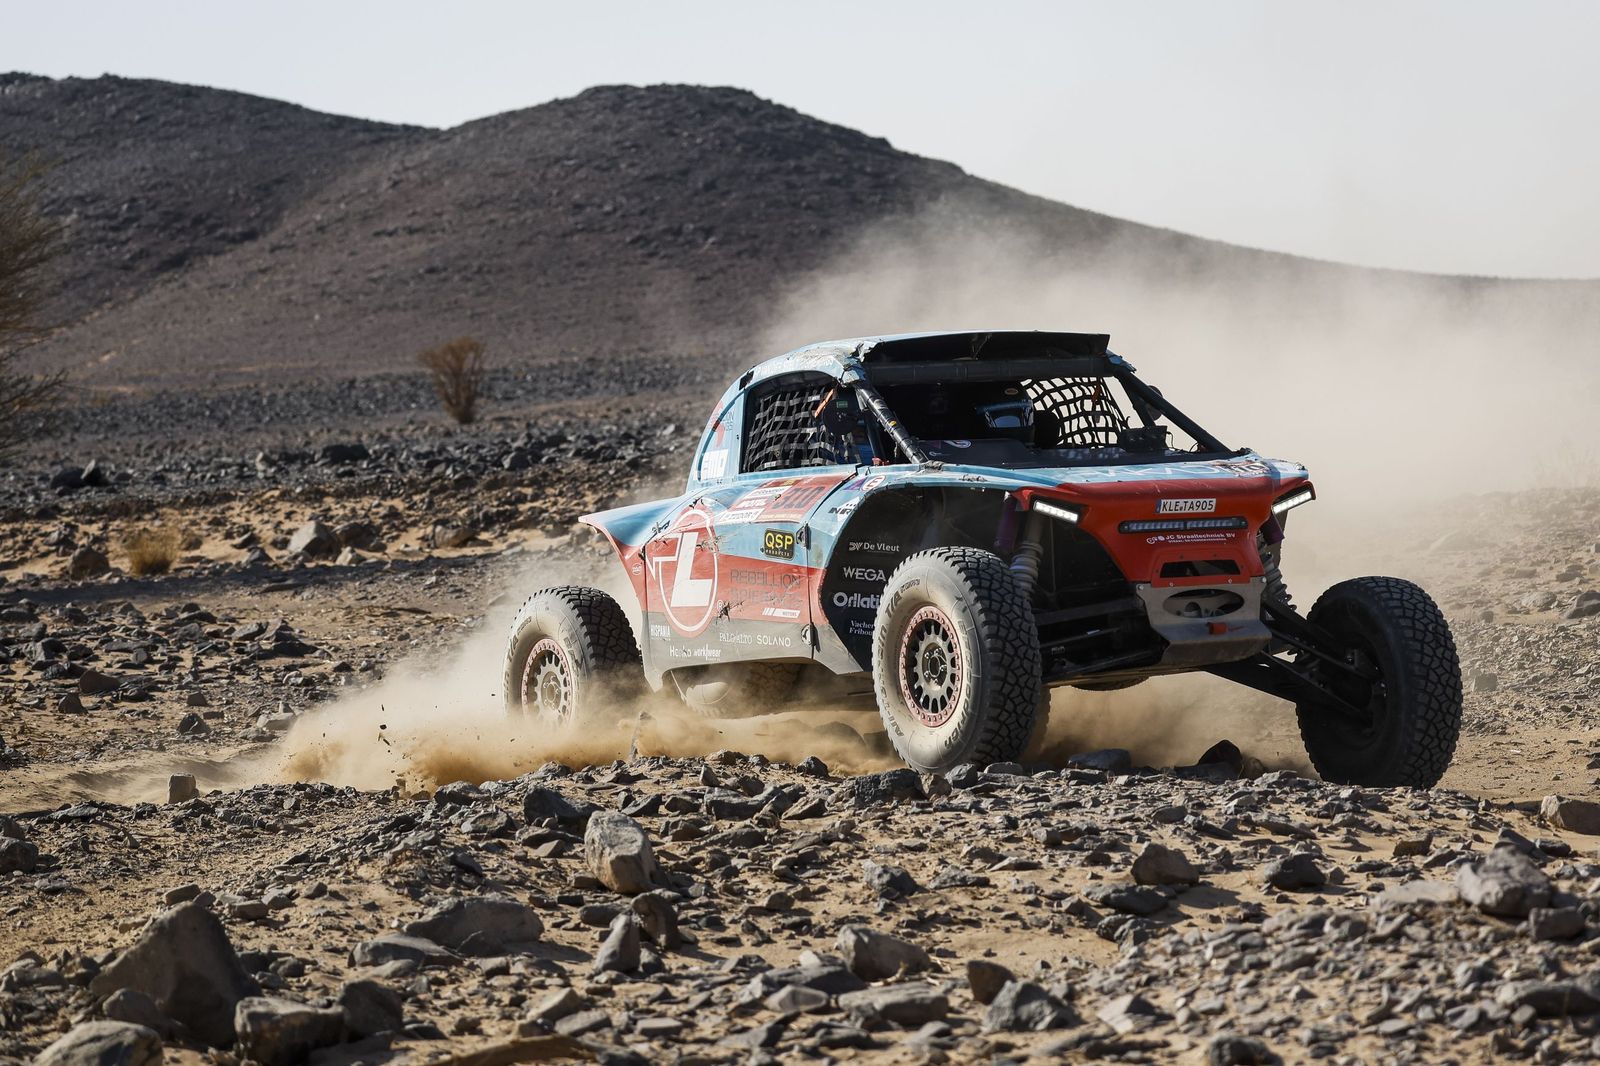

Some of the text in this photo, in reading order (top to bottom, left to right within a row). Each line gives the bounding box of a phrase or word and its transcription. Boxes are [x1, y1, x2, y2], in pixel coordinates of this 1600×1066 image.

[765, 532, 794, 550] QSP
[863, 542, 875, 551] De
[877, 543, 900, 552] Vleut
[843, 566, 886, 582] WEGA
[756, 634, 791, 648] SOLANO
